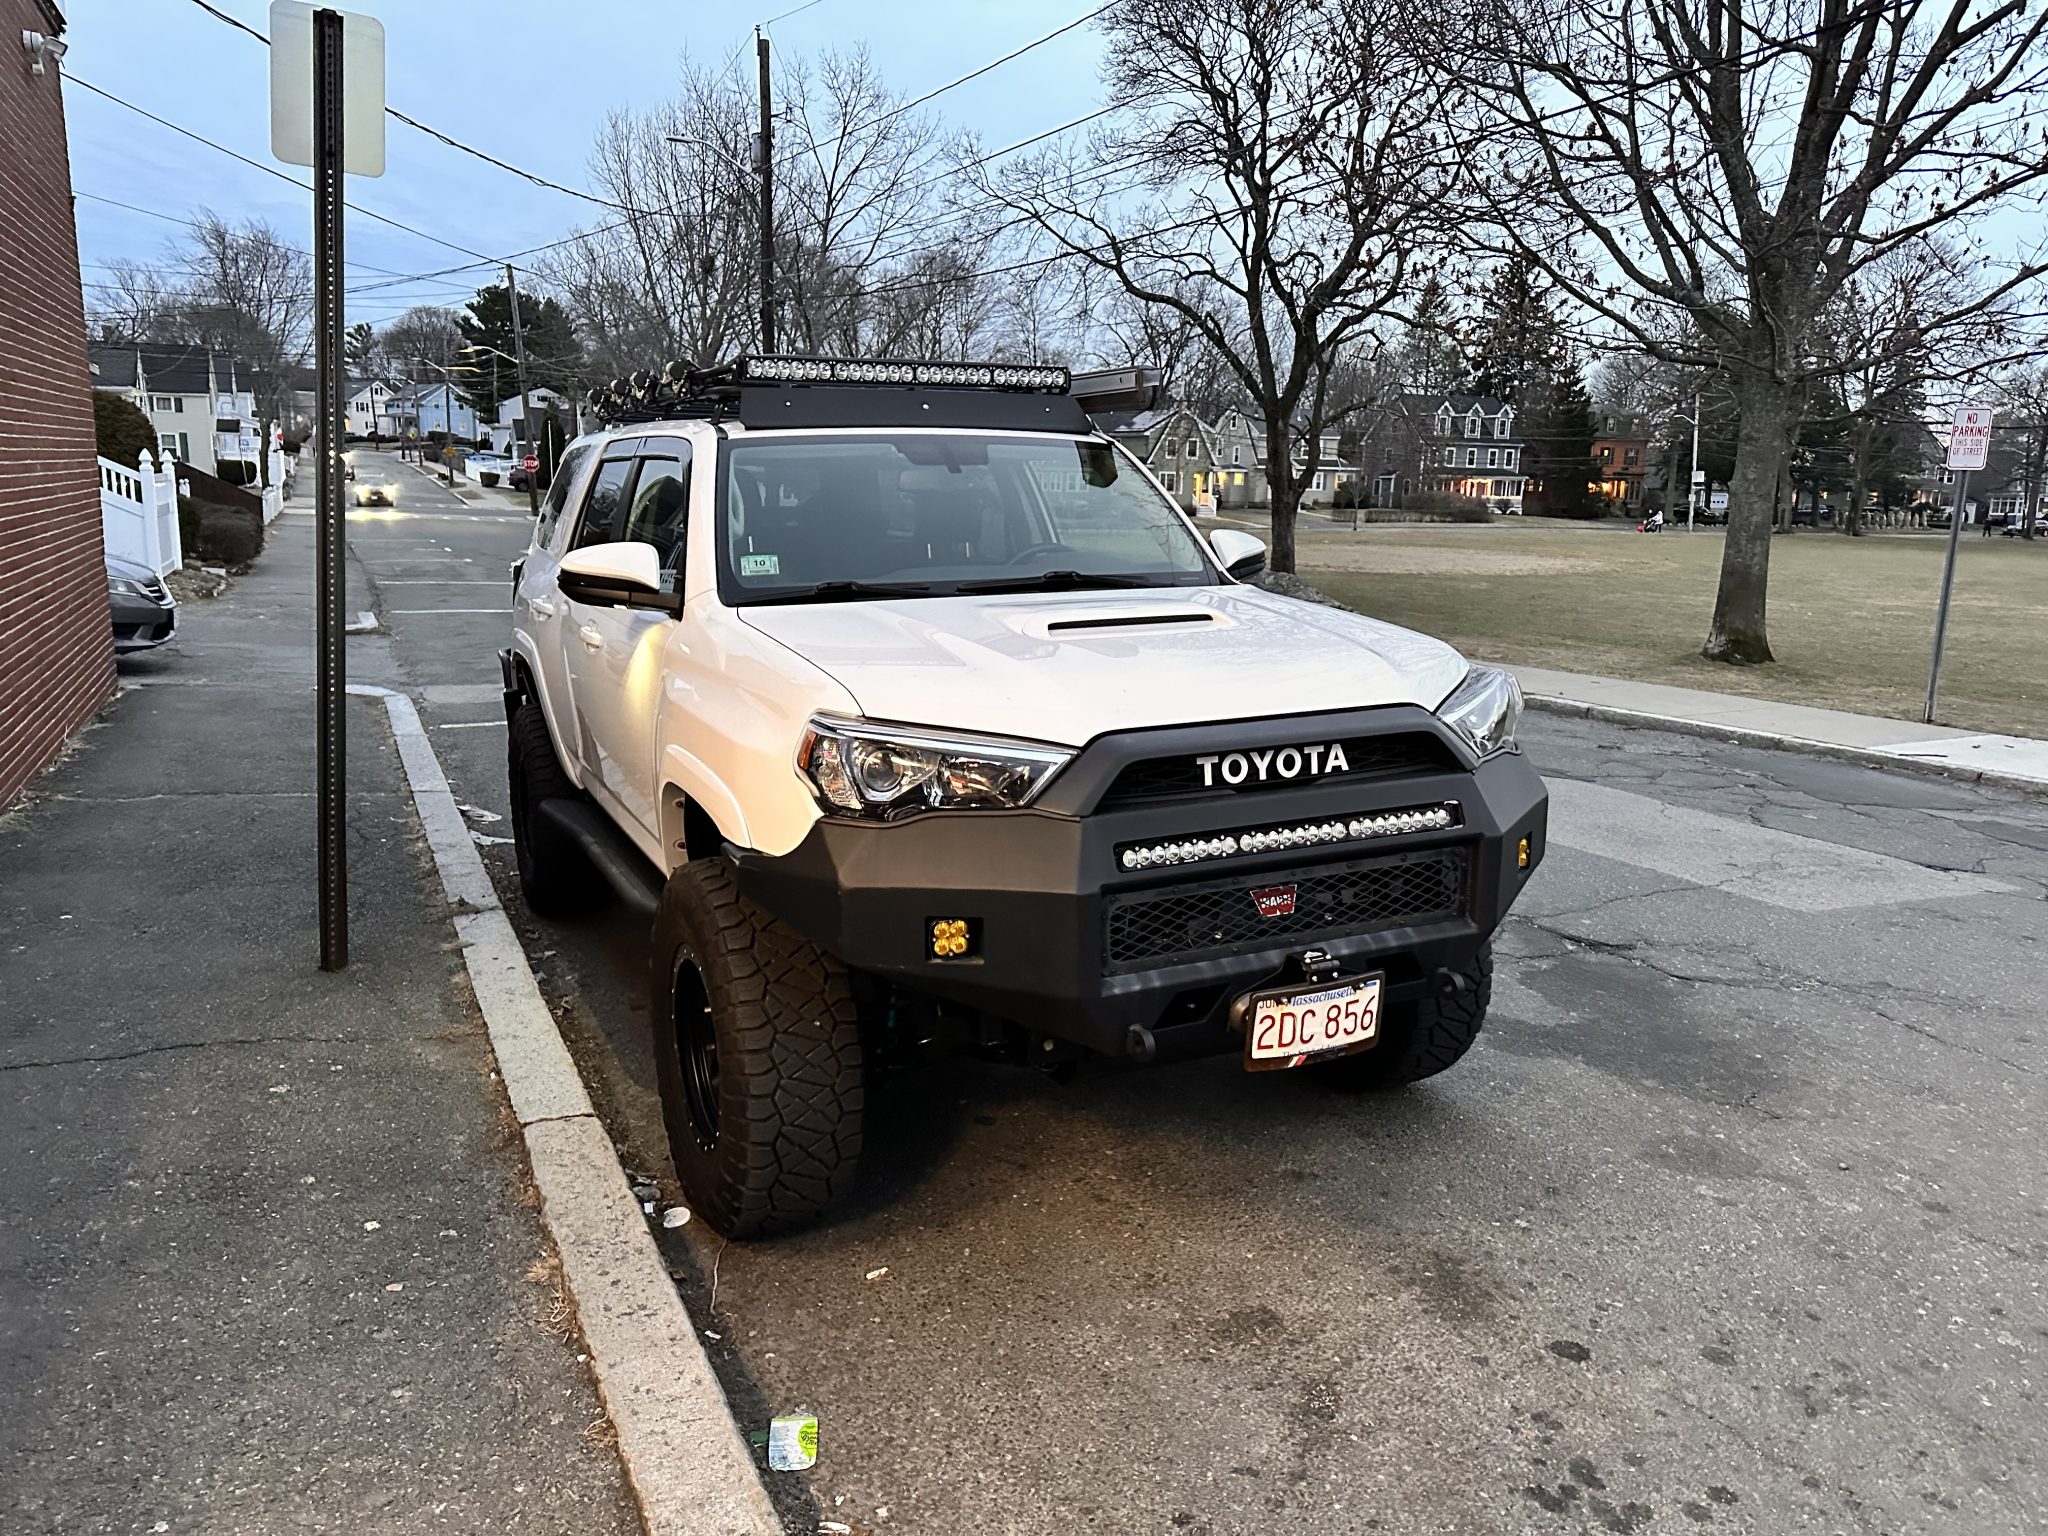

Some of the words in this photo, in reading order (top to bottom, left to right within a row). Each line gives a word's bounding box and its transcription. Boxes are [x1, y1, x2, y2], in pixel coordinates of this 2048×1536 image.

[1967, 413, 1978, 424] NO
[1953, 426, 1987, 437] PARKING
[1956, 439, 1967, 447] THIS
[1970, 439, 1983, 447] SIDE
[1196, 743, 1350, 787] TOYOTA
[1257, 1009, 1316, 1050] 2DC
[1325, 995, 1375, 1039] 856
